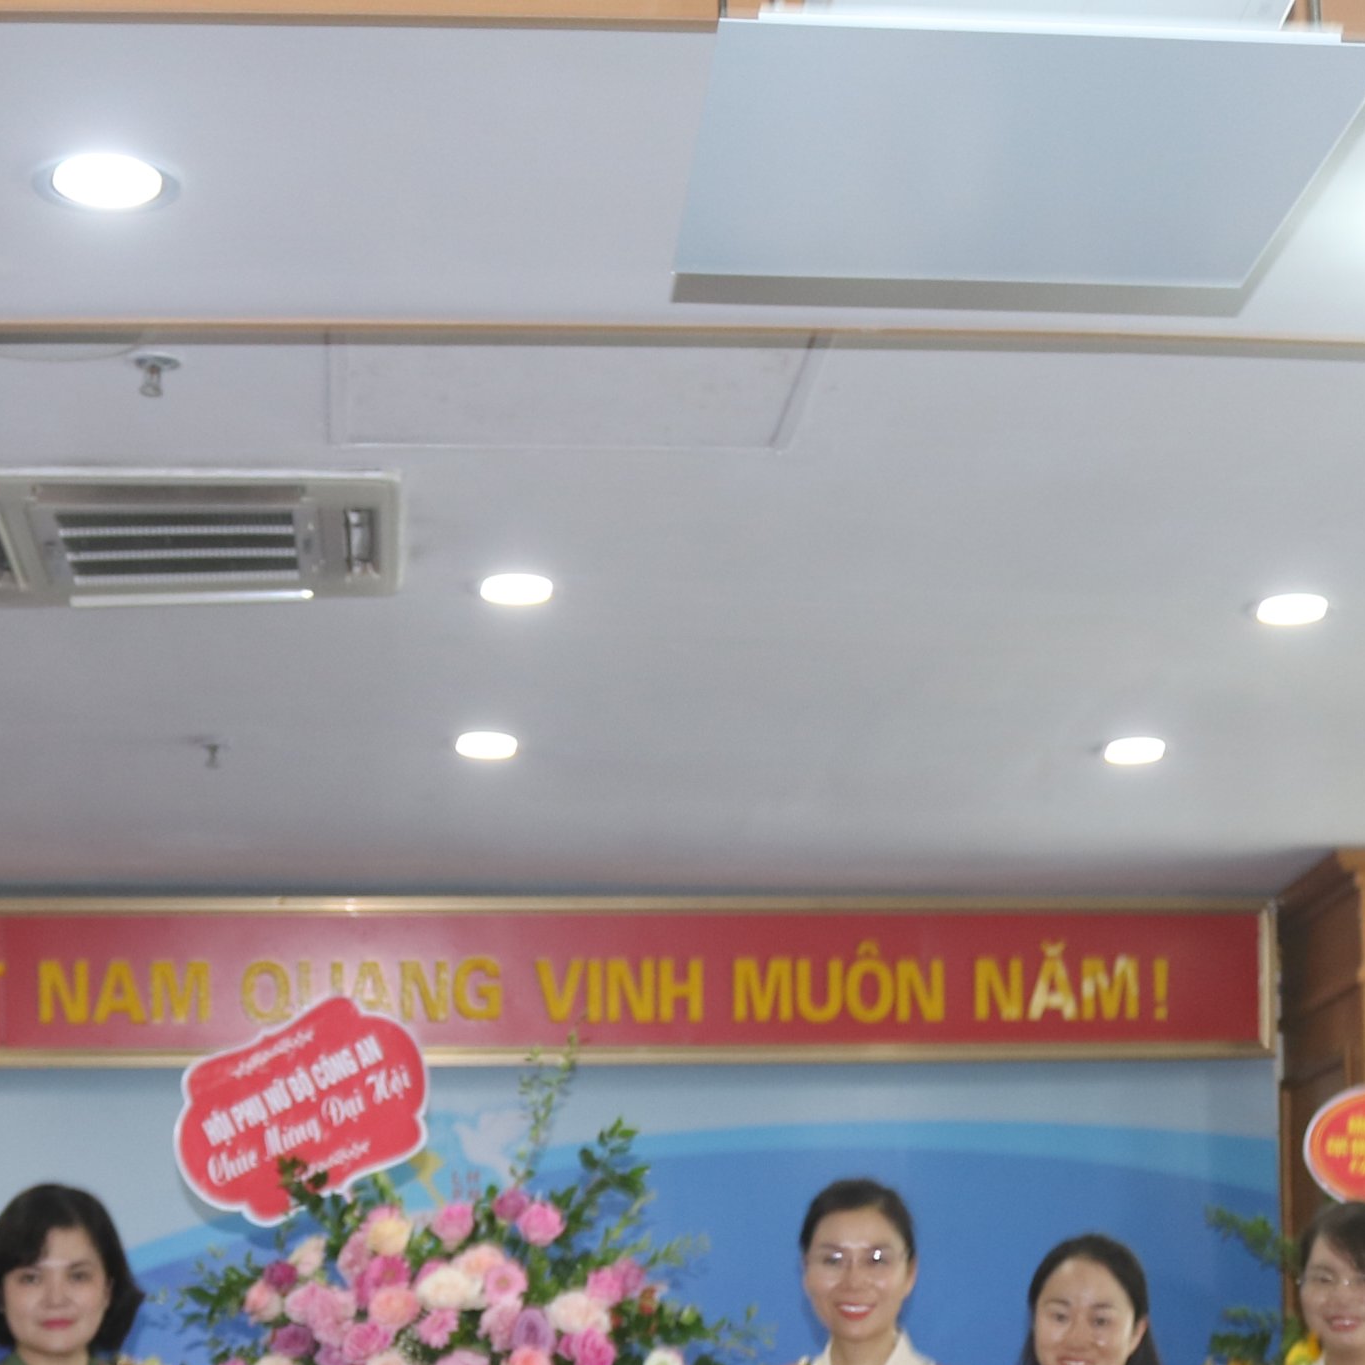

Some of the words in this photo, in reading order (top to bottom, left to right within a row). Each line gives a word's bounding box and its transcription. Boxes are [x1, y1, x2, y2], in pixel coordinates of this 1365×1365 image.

[37, 958, 211, 1026] NAM
[240, 956, 503, 1024] QUANG
[534, 956, 703, 1026] VINH
[733, 939, 946, 1025] MUÔN
